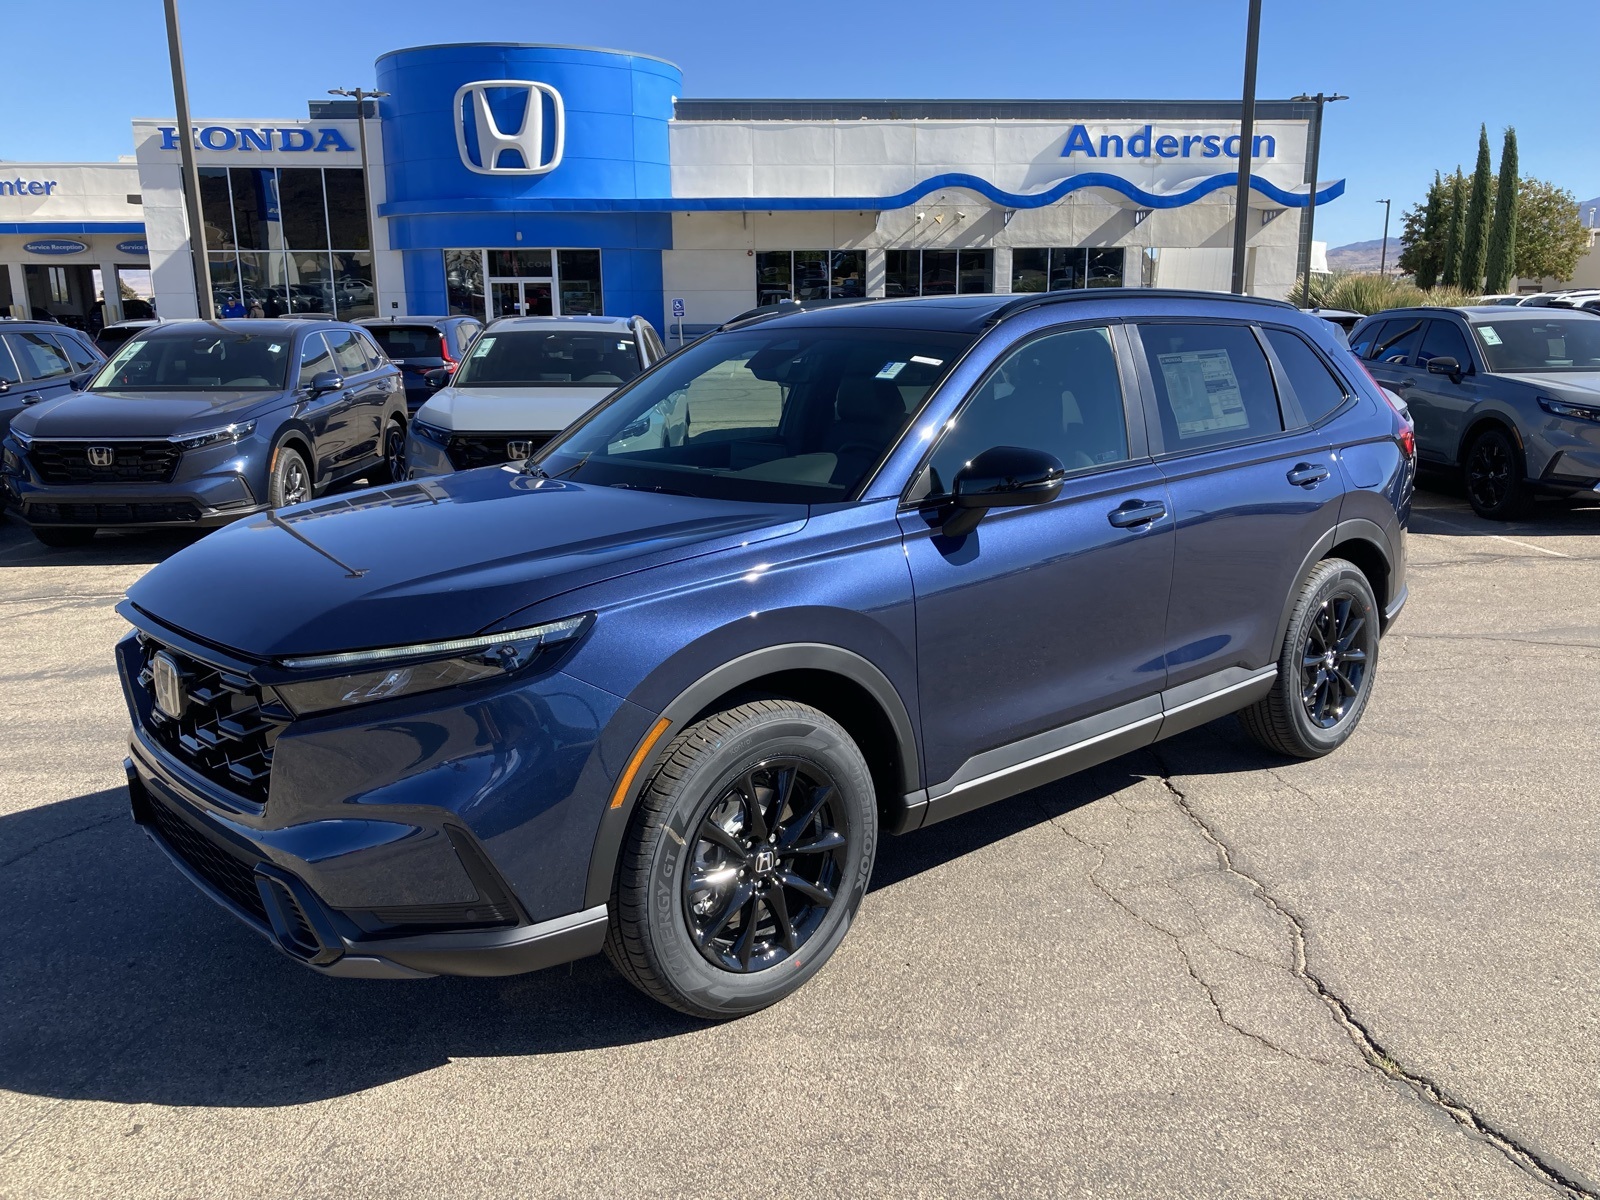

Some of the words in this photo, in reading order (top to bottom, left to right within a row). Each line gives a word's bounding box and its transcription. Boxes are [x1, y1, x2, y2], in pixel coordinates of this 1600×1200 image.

[157, 126, 355, 151] HONDA
[1060, 124, 1276, 158] Anderson
[51, 244, 83, 252] Reception
[662, 848, 677, 878] GT
